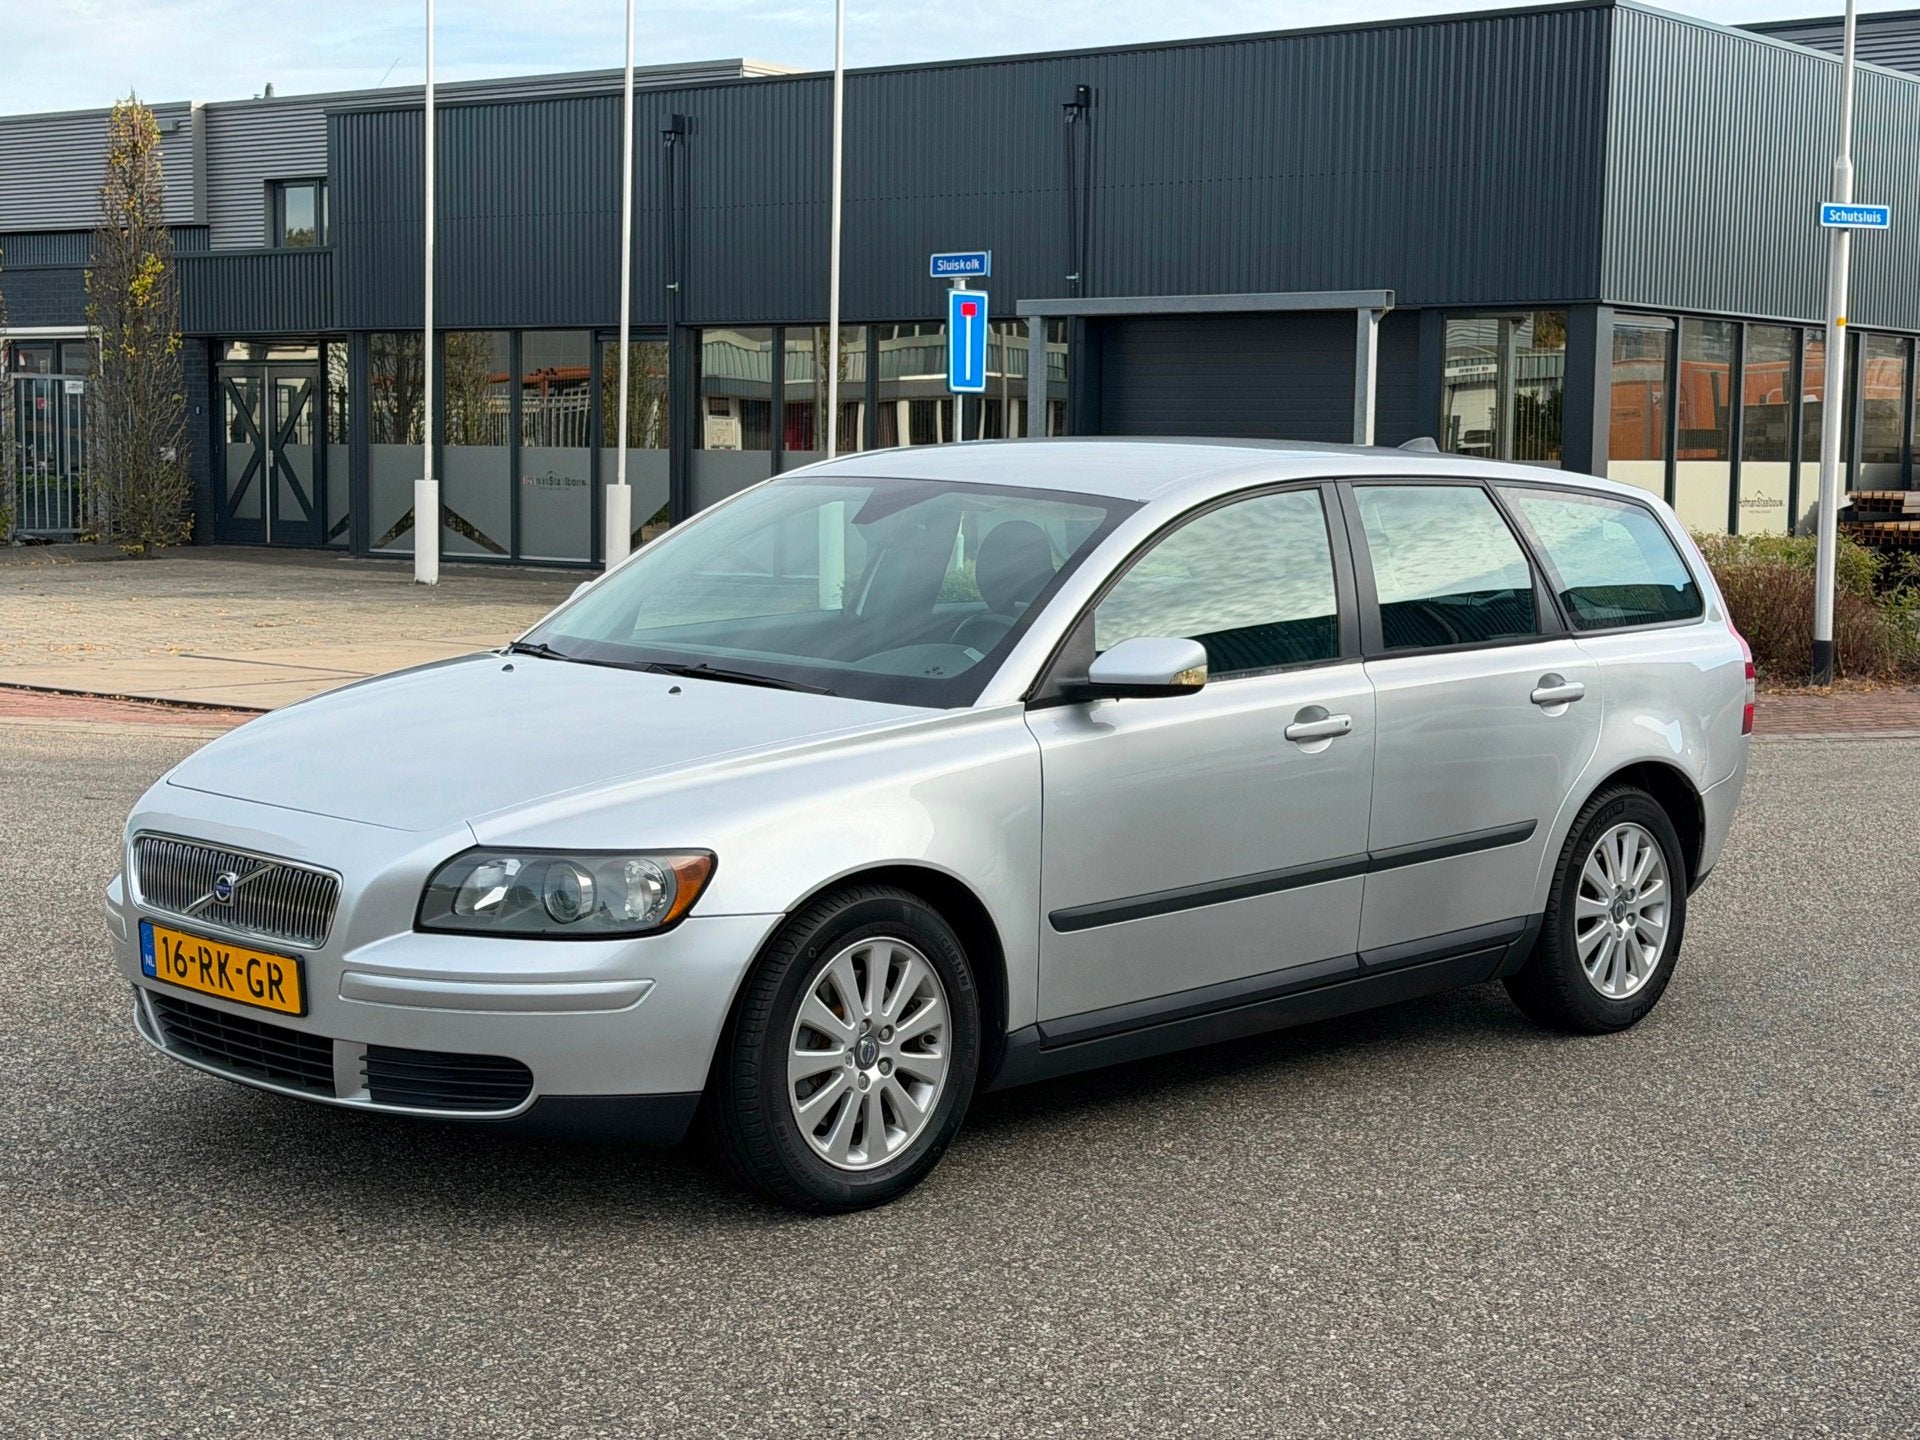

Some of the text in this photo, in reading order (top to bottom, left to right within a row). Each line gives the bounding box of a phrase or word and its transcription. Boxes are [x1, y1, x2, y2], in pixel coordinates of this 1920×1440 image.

[1829, 209, 1882, 223] Schutsluis
[937, 258, 980, 271] Sluiskolk
[145, 953, 156, 968] NL
[162, 936, 286, 1004] 16-RK-GR
